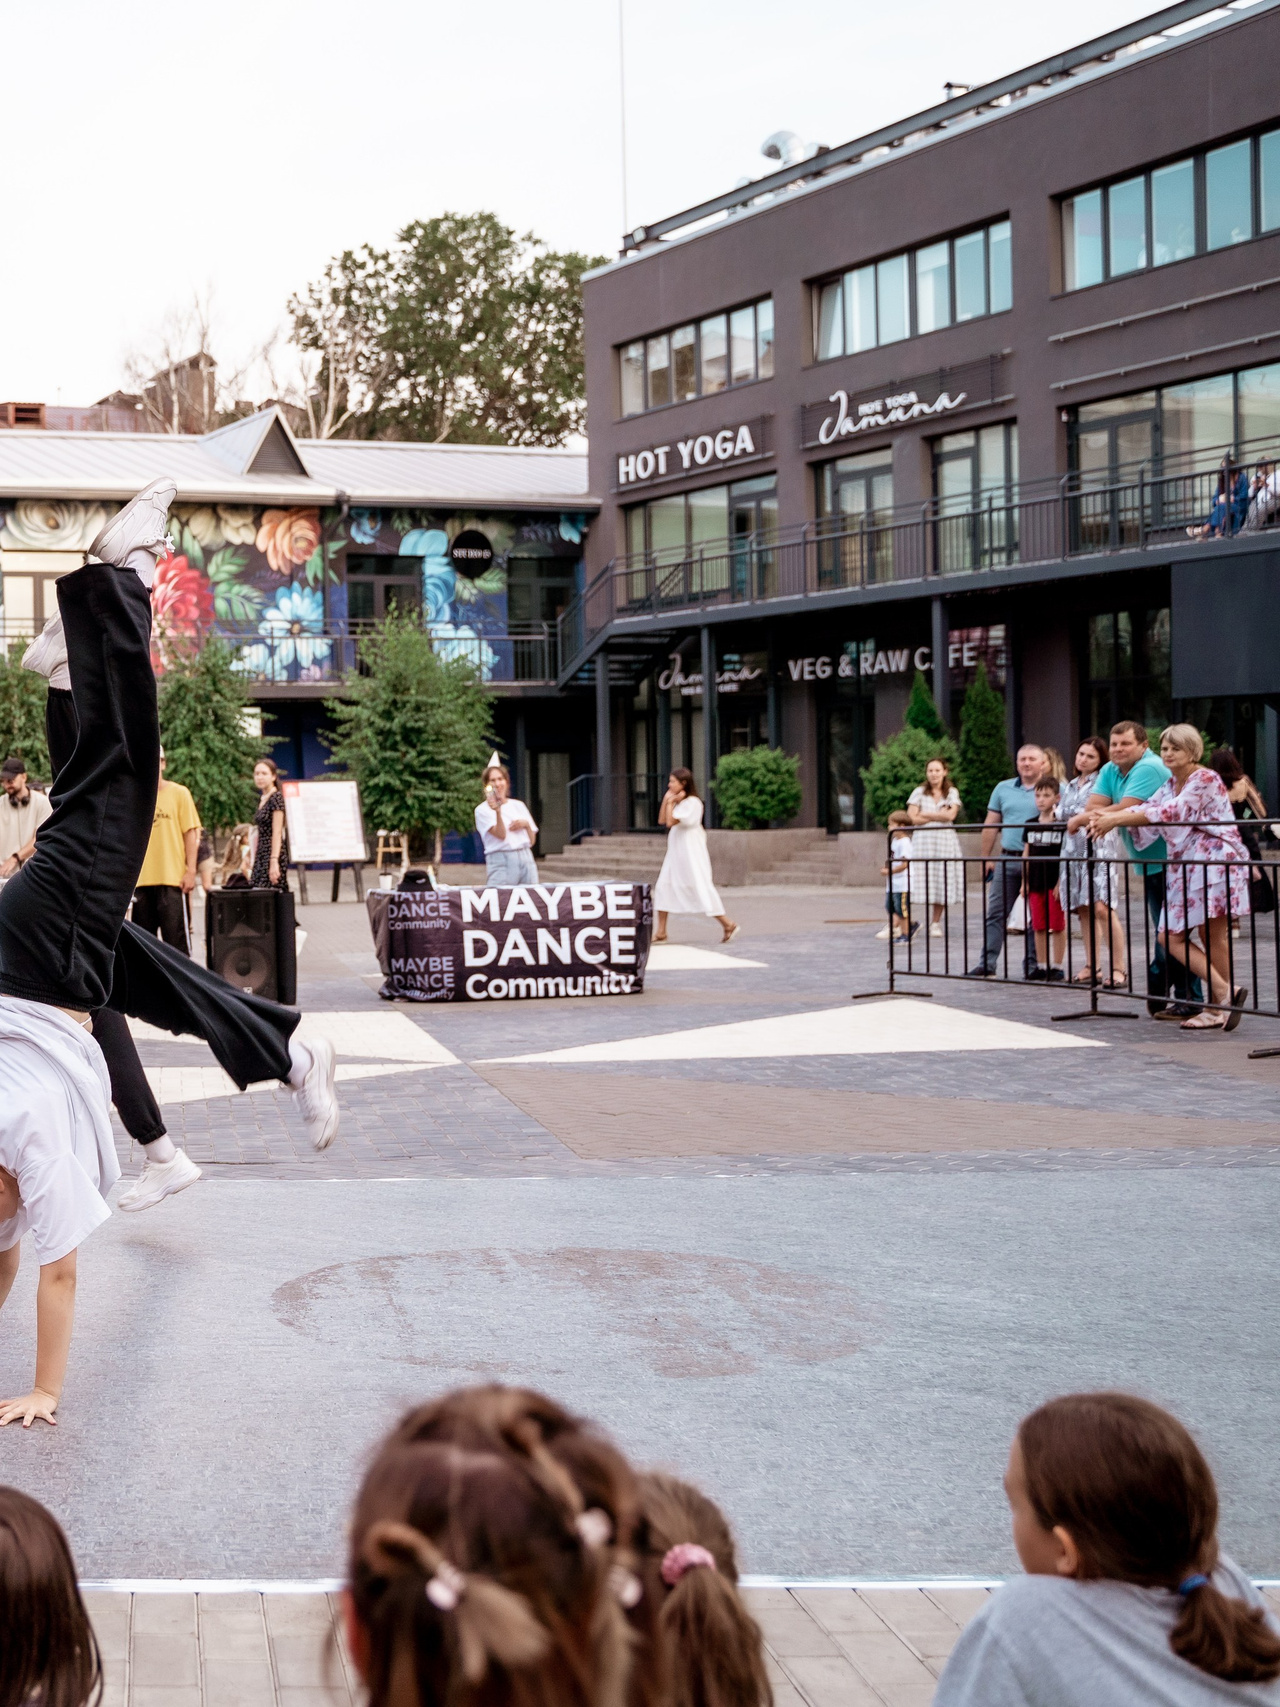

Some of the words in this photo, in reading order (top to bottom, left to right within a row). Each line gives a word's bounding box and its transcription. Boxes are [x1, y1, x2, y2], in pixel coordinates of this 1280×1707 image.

[618, 445, 671, 484] HOT
[677, 424, 756, 469] YOGA
[787, 655, 834, 682] VEG
[837, 652, 854, 679] &
[859, 647, 910, 676] RAW
[913, 642, 979, 672] CFE
[387, 902, 451, 918] DANCE
[460, 883, 636, 923] MAYBE
[388, 918, 451, 930] Community
[462, 926, 637, 967] DANCE
[391, 956, 455, 973] MAYBE
[392, 973, 456, 988] DANCE
[465, 969, 636, 999] Community
